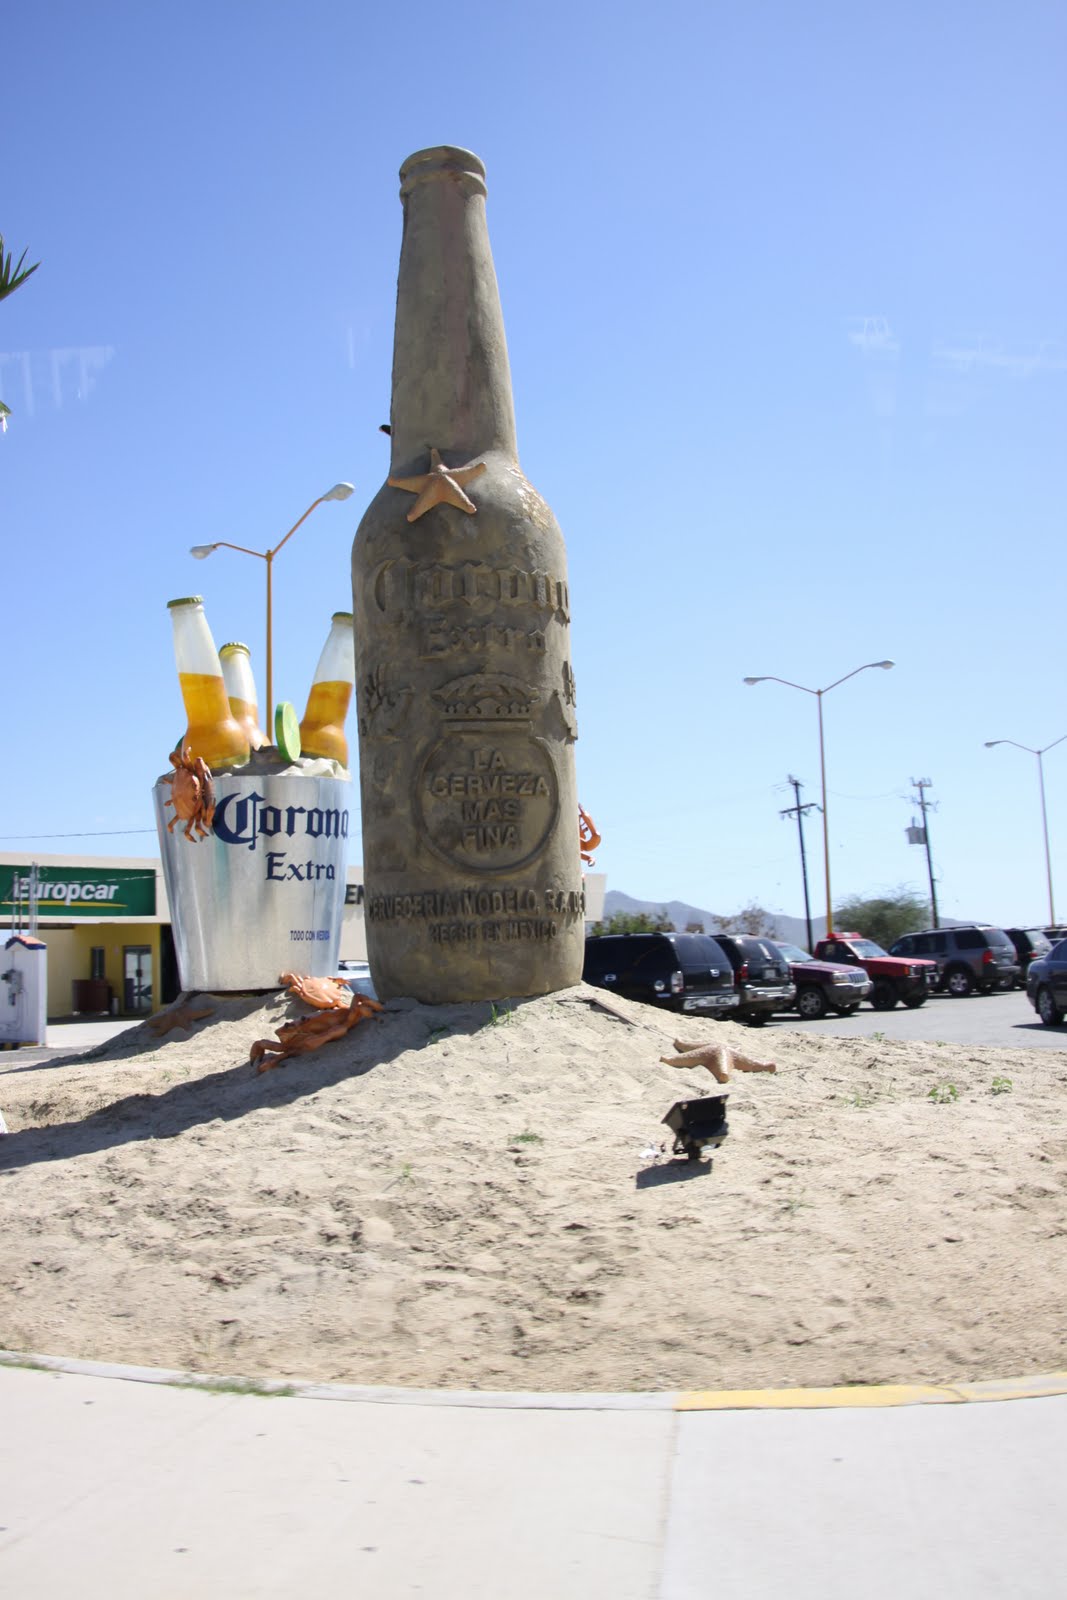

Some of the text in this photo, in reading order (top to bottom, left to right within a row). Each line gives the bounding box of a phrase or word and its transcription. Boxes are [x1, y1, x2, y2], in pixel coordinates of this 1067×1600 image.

[473, 748, 507, 770] LA
[430, 774, 550, 798] CERVEZA
[212, 791, 350, 850] Corona
[462, 799, 521, 821] MAS
[462, 825, 523, 850] FINA
[264, 852, 336, 881] Extra
[13, 876, 120, 906] Europcar
